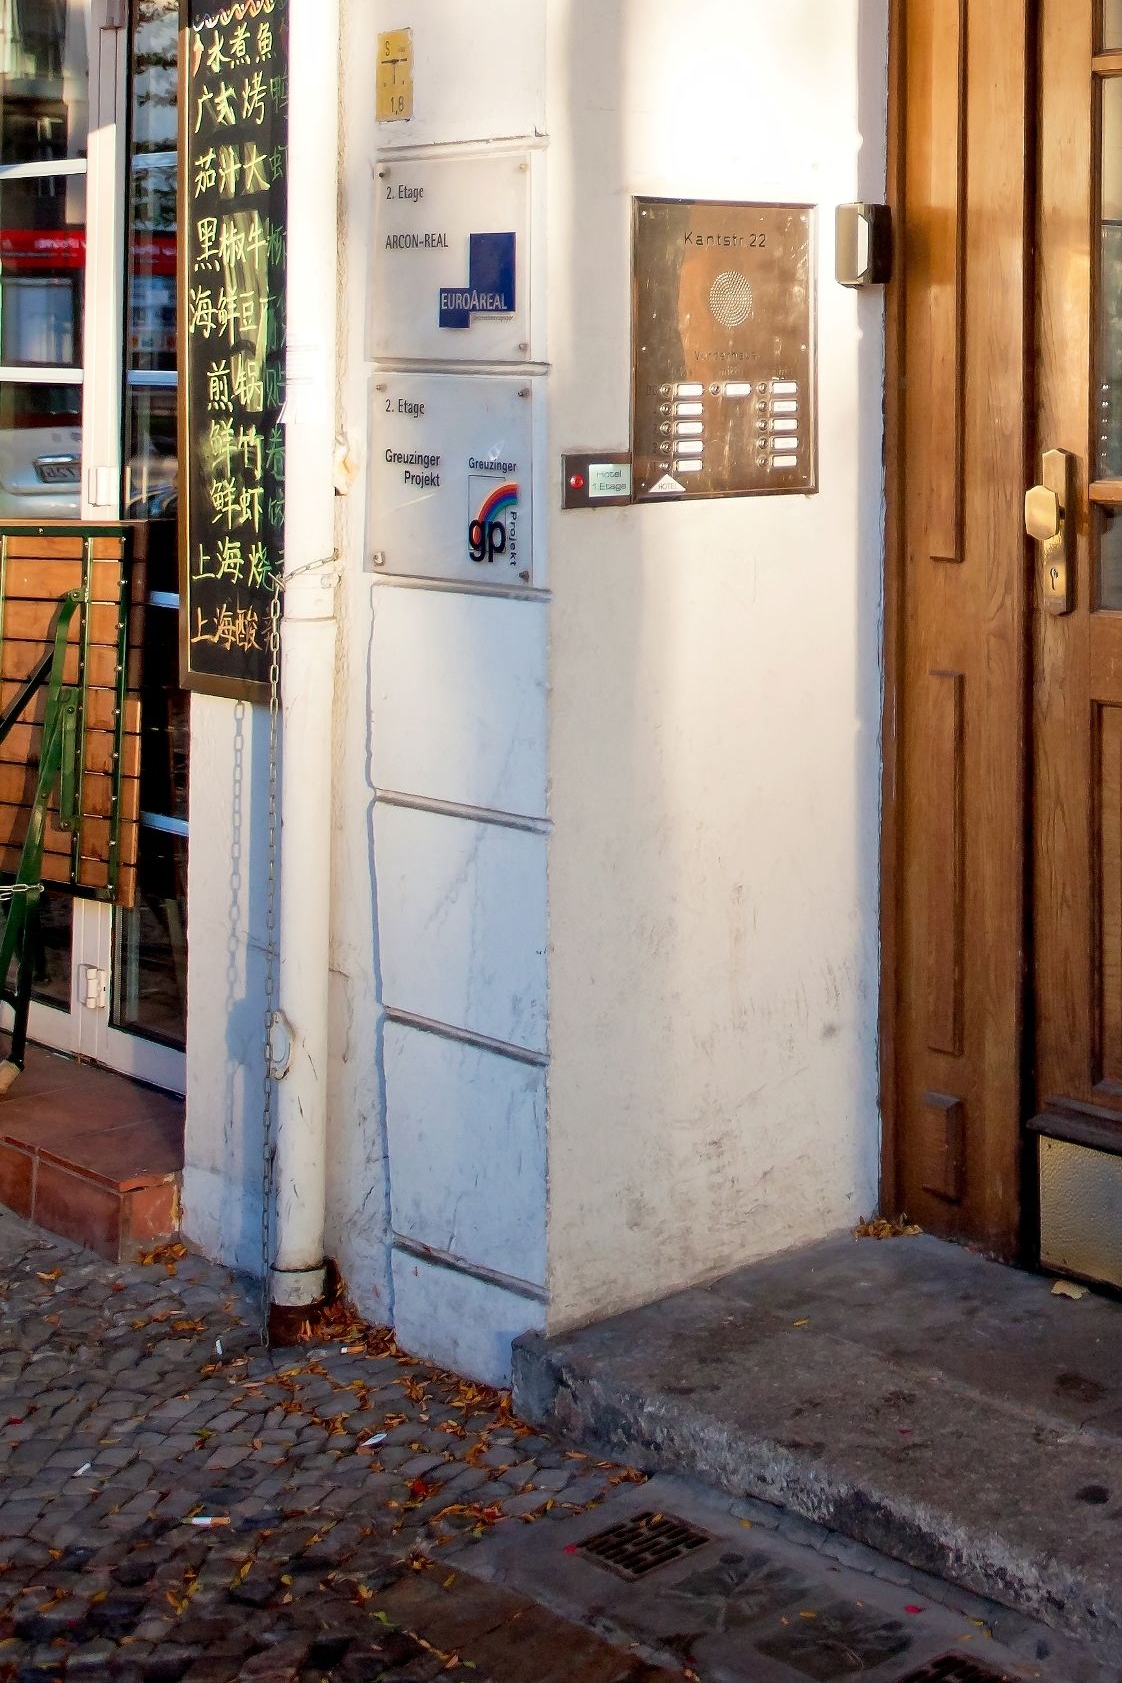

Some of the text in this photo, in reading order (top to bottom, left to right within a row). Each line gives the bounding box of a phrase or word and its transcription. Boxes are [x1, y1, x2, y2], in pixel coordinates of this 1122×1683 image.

[386, 184, 425, 203] 2. Etage
[385, 233, 449, 249] ARCON-REAL
[749, 233, 767, 249] 22
[385, 398, 425, 418] 2. Etage
[385, 448, 441, 467] Greuzinger
[468, 457, 517, 474] Greuzinger
[404, 470, 441, 489] Projekt
[596, 469, 622, 479] Hotel
[658, 482, 677, 490] HOTEL
[191, 535, 284, 592] 上海烧
